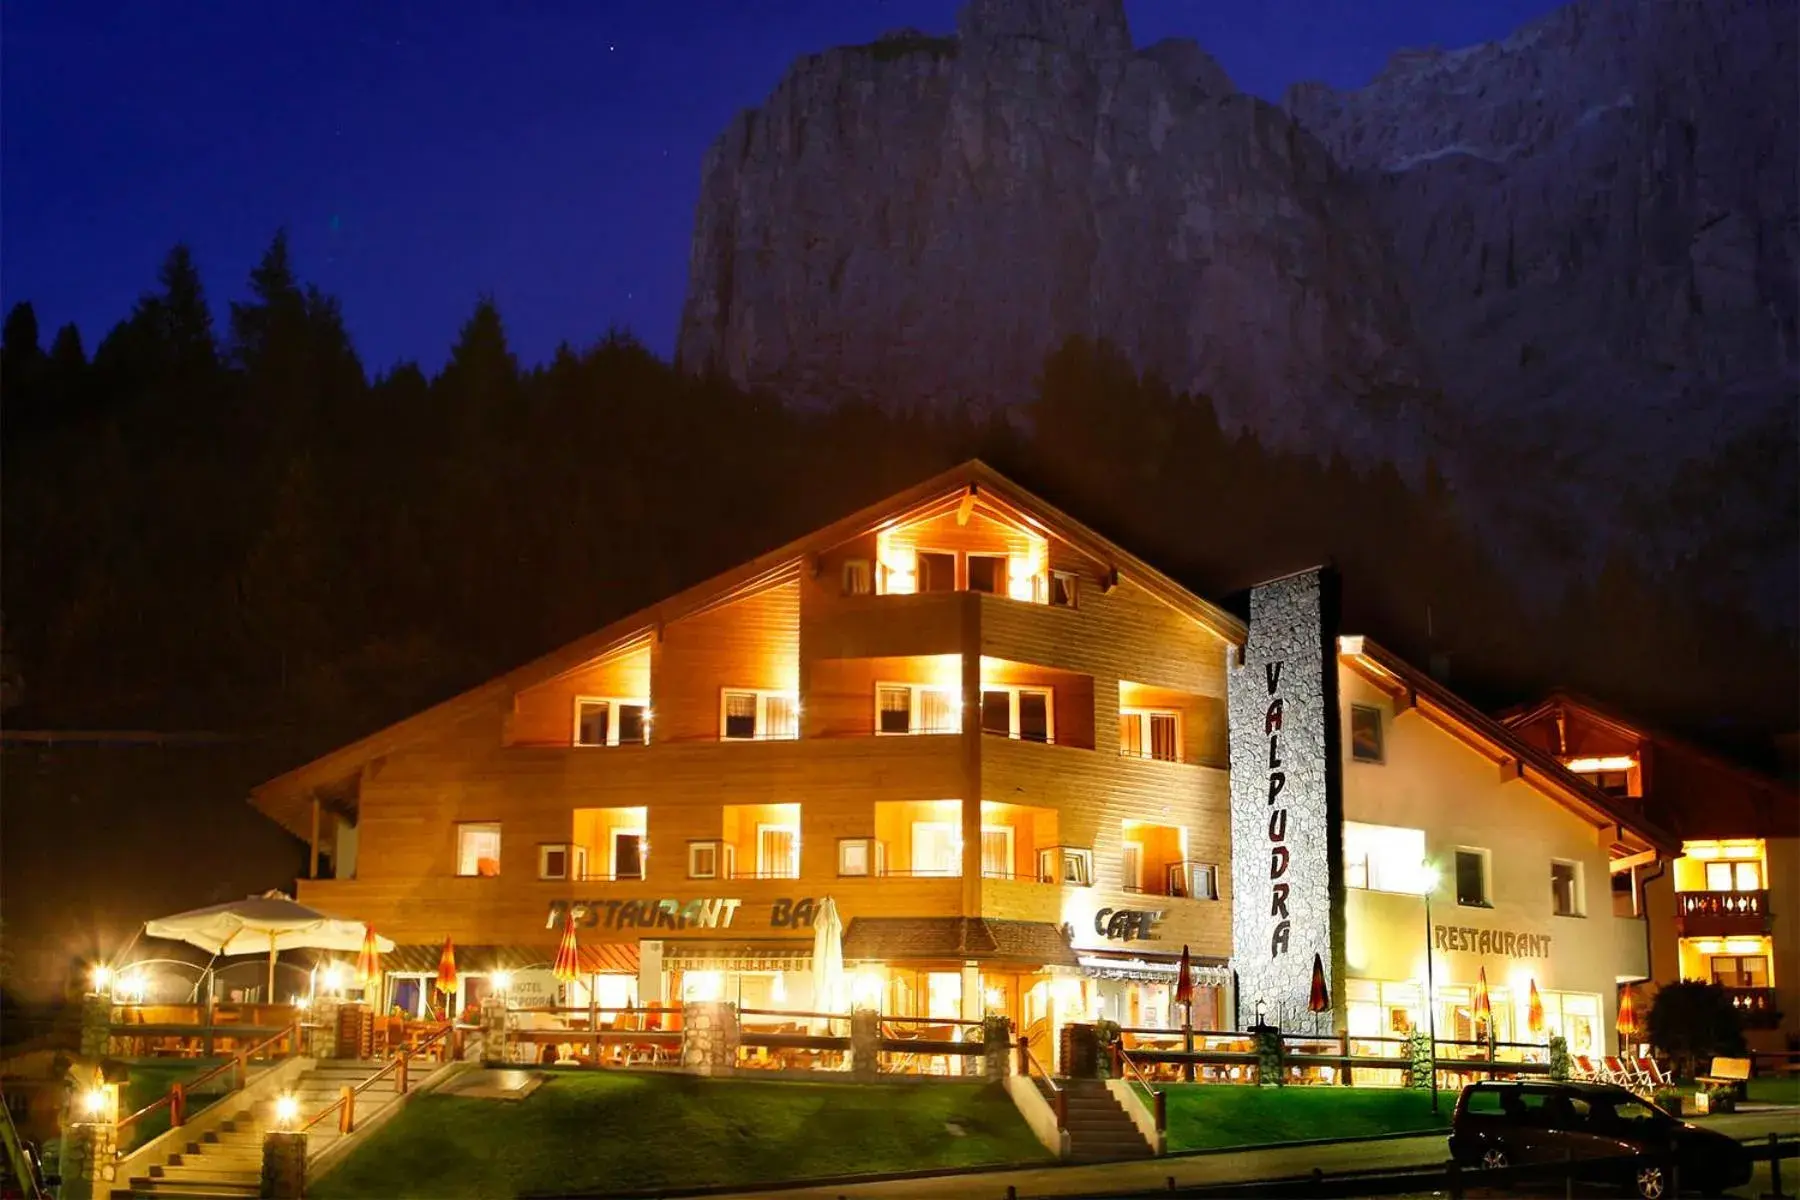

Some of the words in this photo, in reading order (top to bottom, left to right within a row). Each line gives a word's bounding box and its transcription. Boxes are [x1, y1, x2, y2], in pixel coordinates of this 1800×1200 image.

[1265, 661, 1291, 957] VALPUDRA
[545, 898, 741, 930] RESTAURANT
[770, 897, 823, 929] BA
[1434, 924, 1551, 958] RESTAURANT
